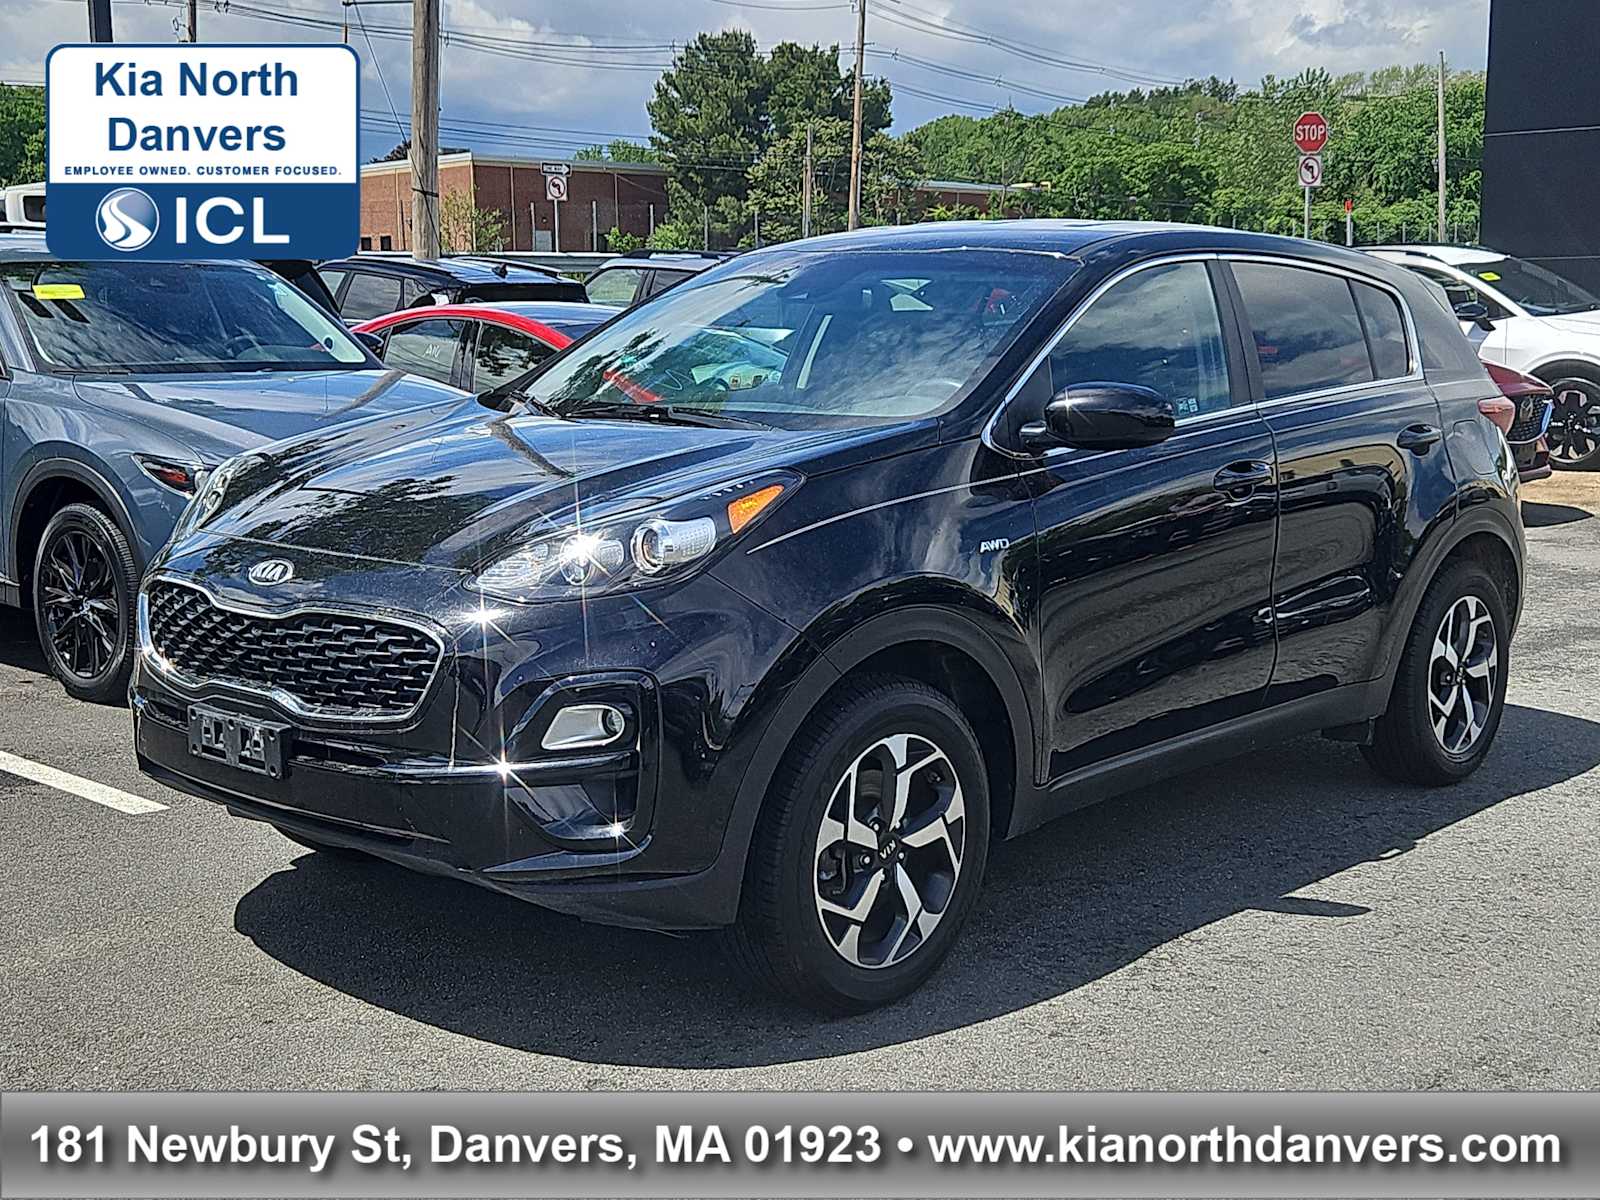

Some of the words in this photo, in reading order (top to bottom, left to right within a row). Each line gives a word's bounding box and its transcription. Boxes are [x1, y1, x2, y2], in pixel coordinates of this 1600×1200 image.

[1296, 125, 1325, 141] STOP
[980, 538, 1010, 553] AWD
[879, 840, 897, 859] KIA
